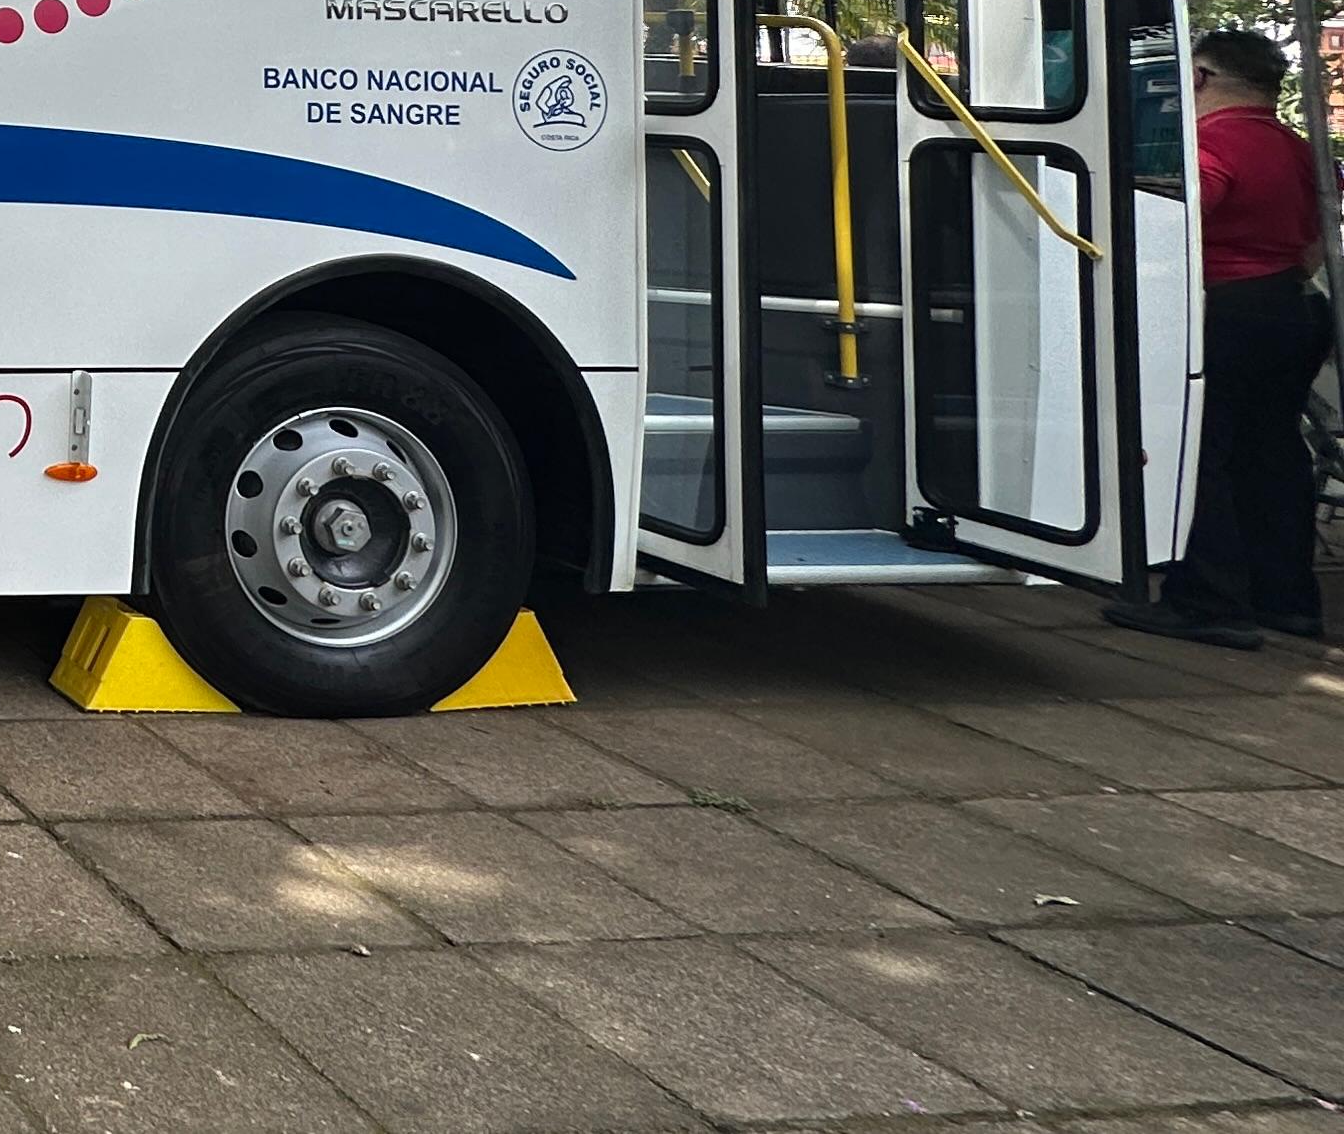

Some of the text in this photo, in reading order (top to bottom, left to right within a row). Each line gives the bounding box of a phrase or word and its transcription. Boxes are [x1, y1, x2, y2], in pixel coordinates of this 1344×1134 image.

[263, 66, 503, 94] BANCO NACIONAL
[519, 56, 602, 113] SEGURO SOCIAL
[307, 102, 461, 126] DE SANGRE
